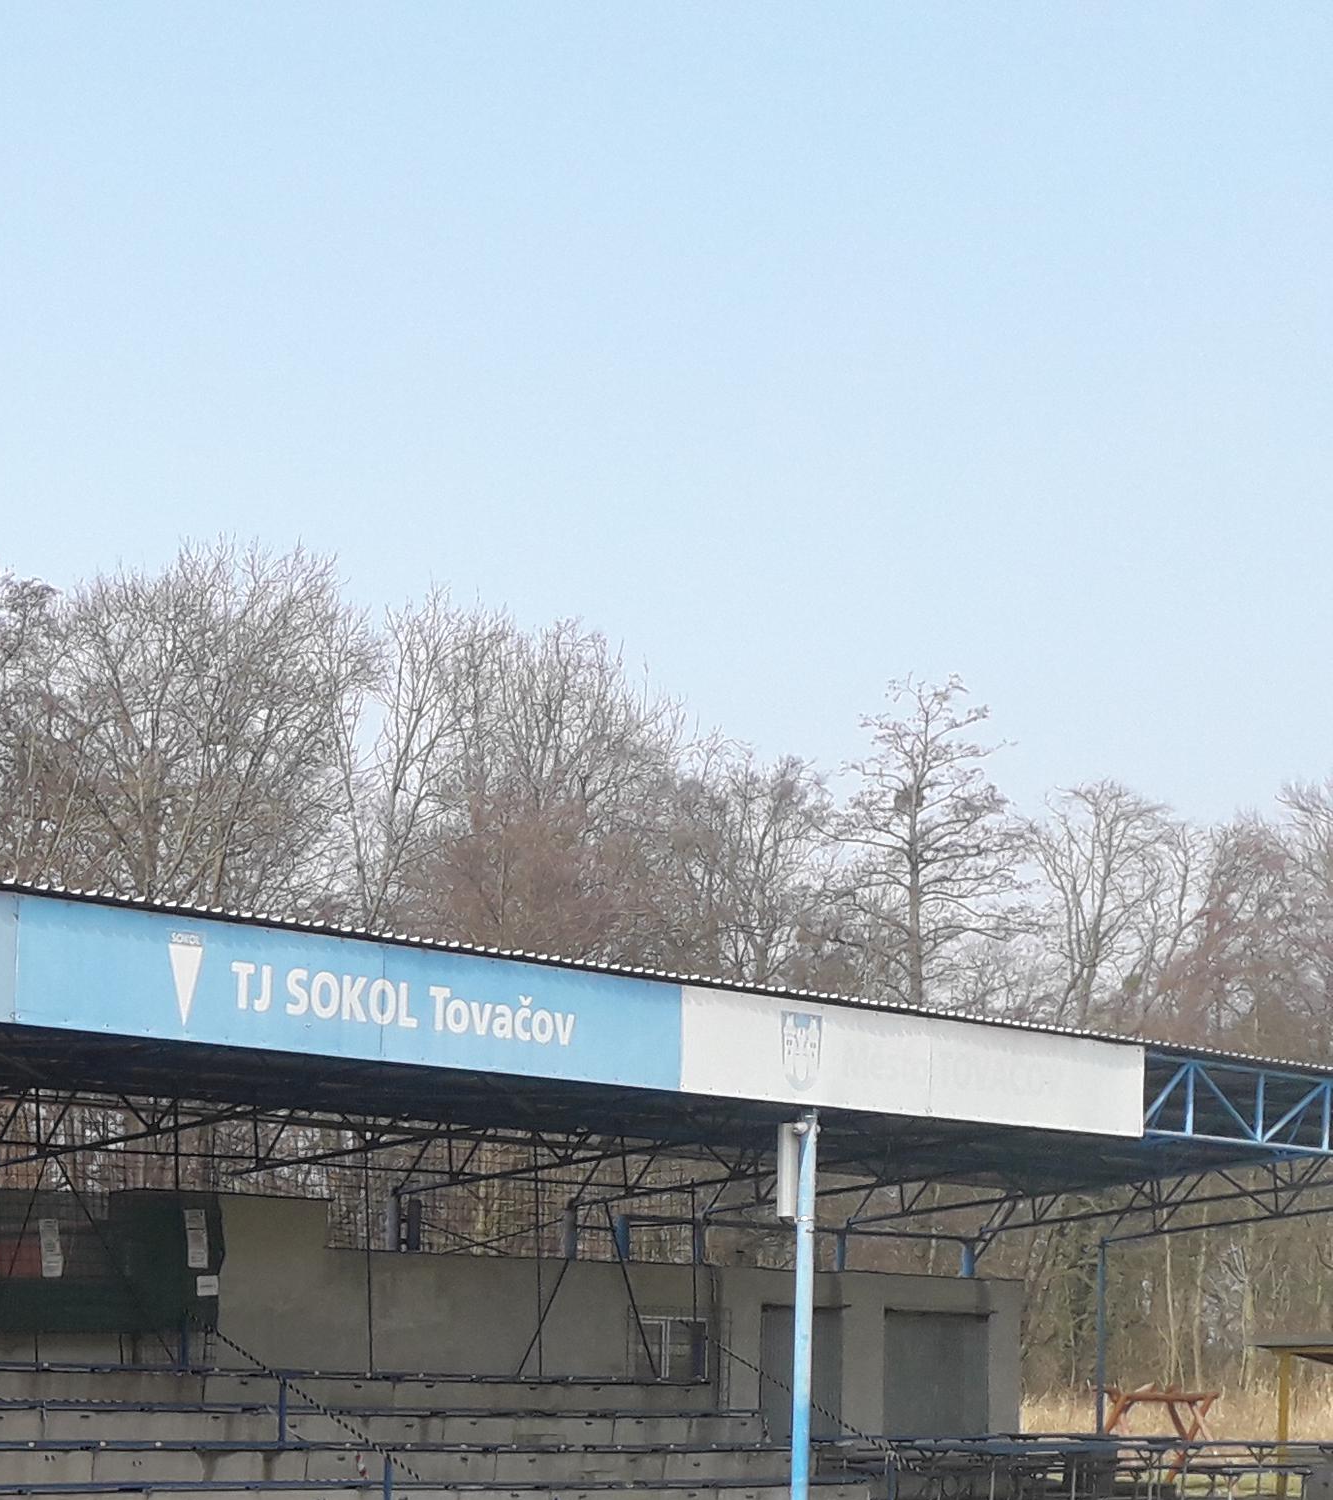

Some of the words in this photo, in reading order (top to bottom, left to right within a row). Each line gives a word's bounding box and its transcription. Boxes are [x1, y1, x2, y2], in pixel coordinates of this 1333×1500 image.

[170, 931, 202, 946] SOKOL
[230, 959, 274, 1013] TJ
[284, 966, 419, 1030] SOKOL
[428, 985, 577, 1047] Tovačov
